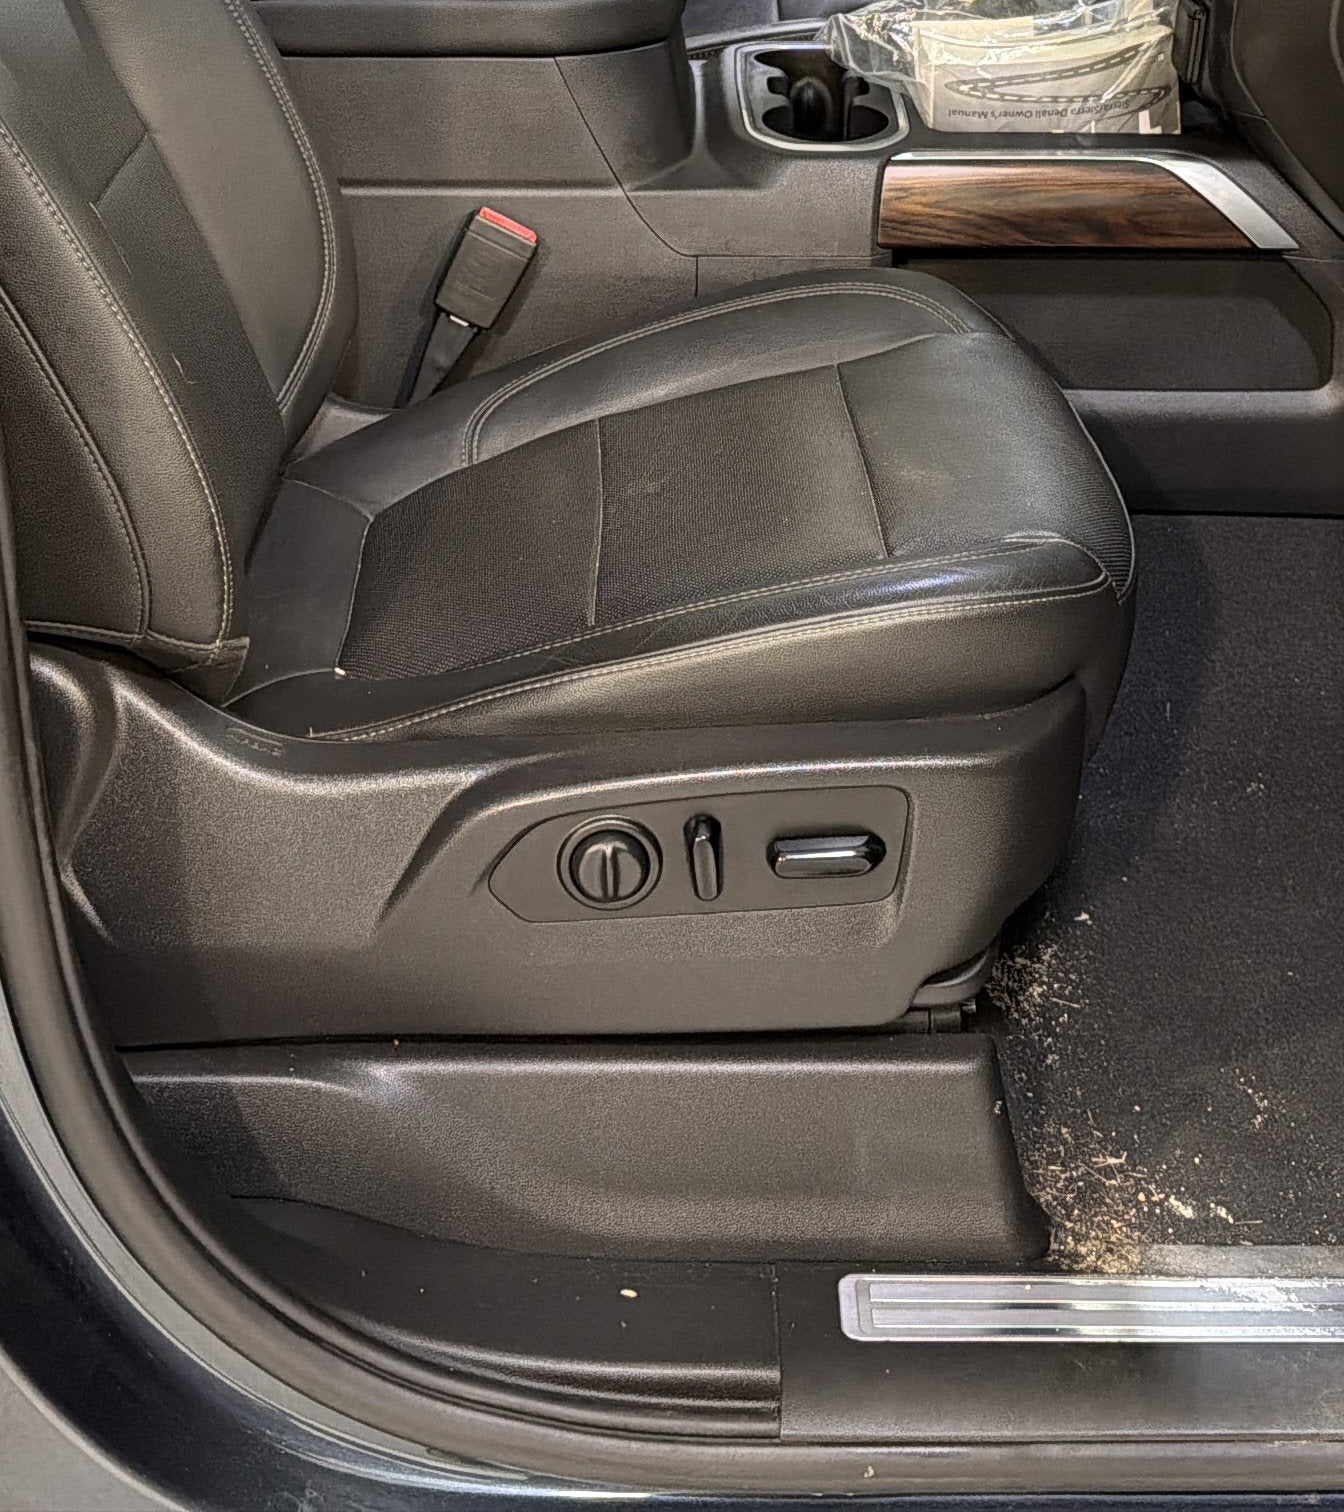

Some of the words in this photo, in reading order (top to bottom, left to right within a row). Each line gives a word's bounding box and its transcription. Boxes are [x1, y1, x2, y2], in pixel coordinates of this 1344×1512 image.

[948, 109, 989, 119] Manual
[990, 110, 1033, 120] Owner's
[1035, 108, 1068, 119] Denali
